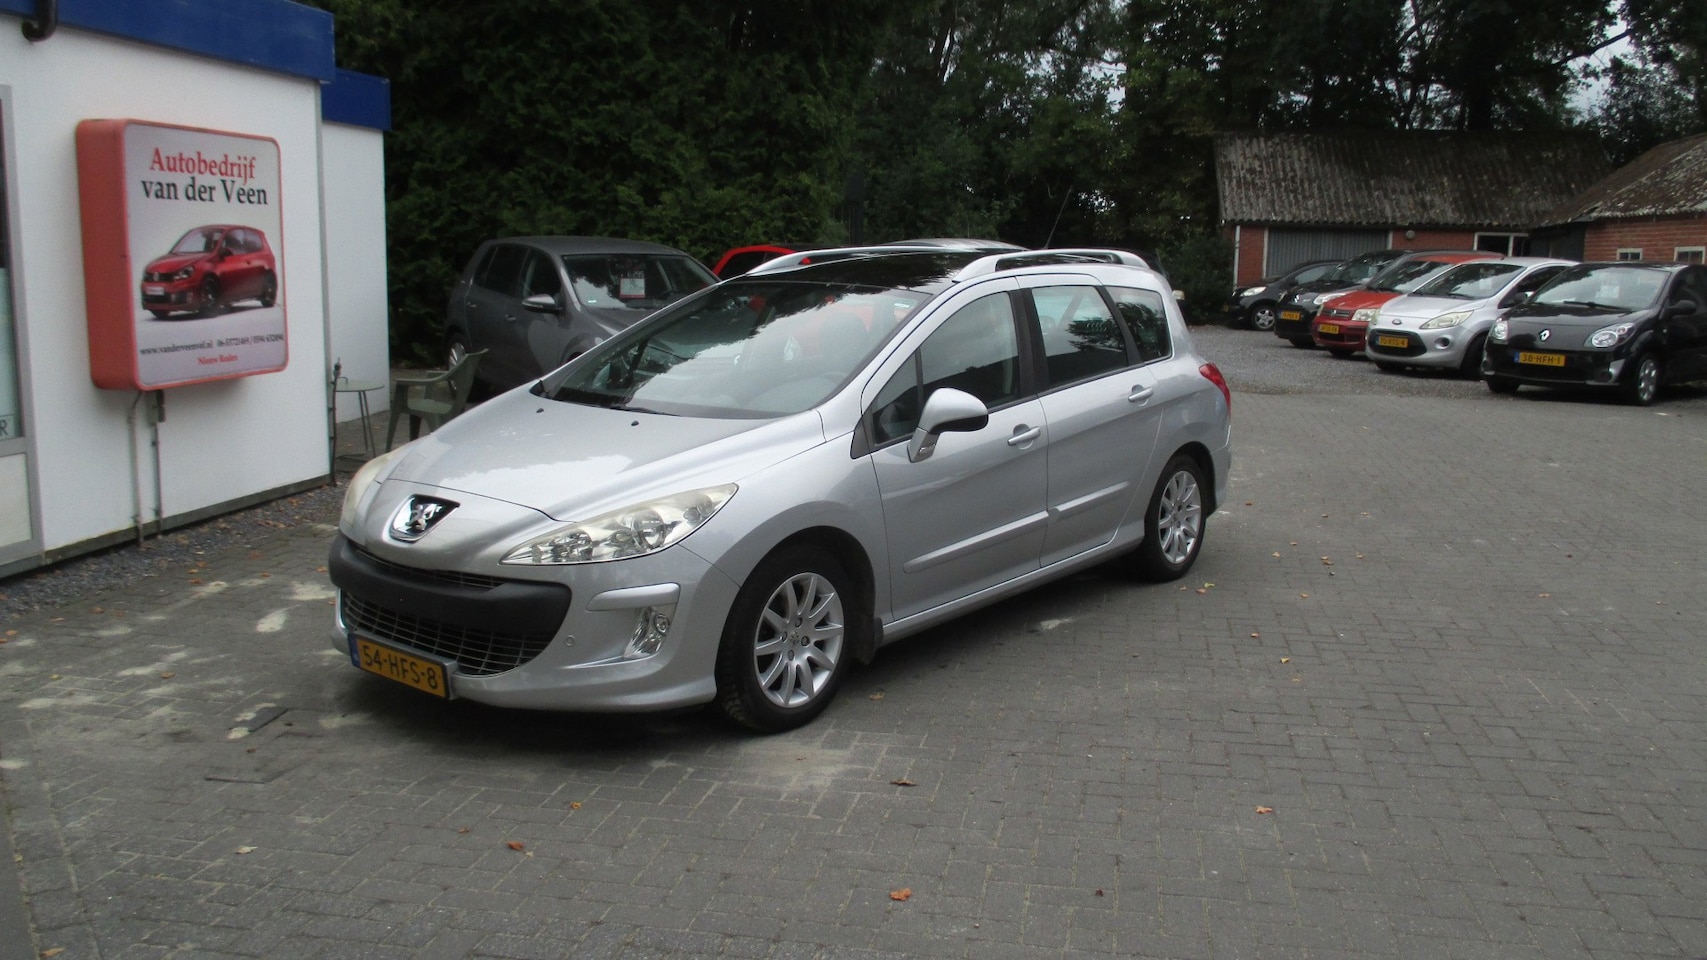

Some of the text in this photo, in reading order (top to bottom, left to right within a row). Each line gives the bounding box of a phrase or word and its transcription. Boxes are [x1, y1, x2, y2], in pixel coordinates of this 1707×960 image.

[150, 147, 256, 185] Autobedrijf
[141, 176, 268, 205] van der Veen
[362, 645, 439, 690] 54-HFS-8
